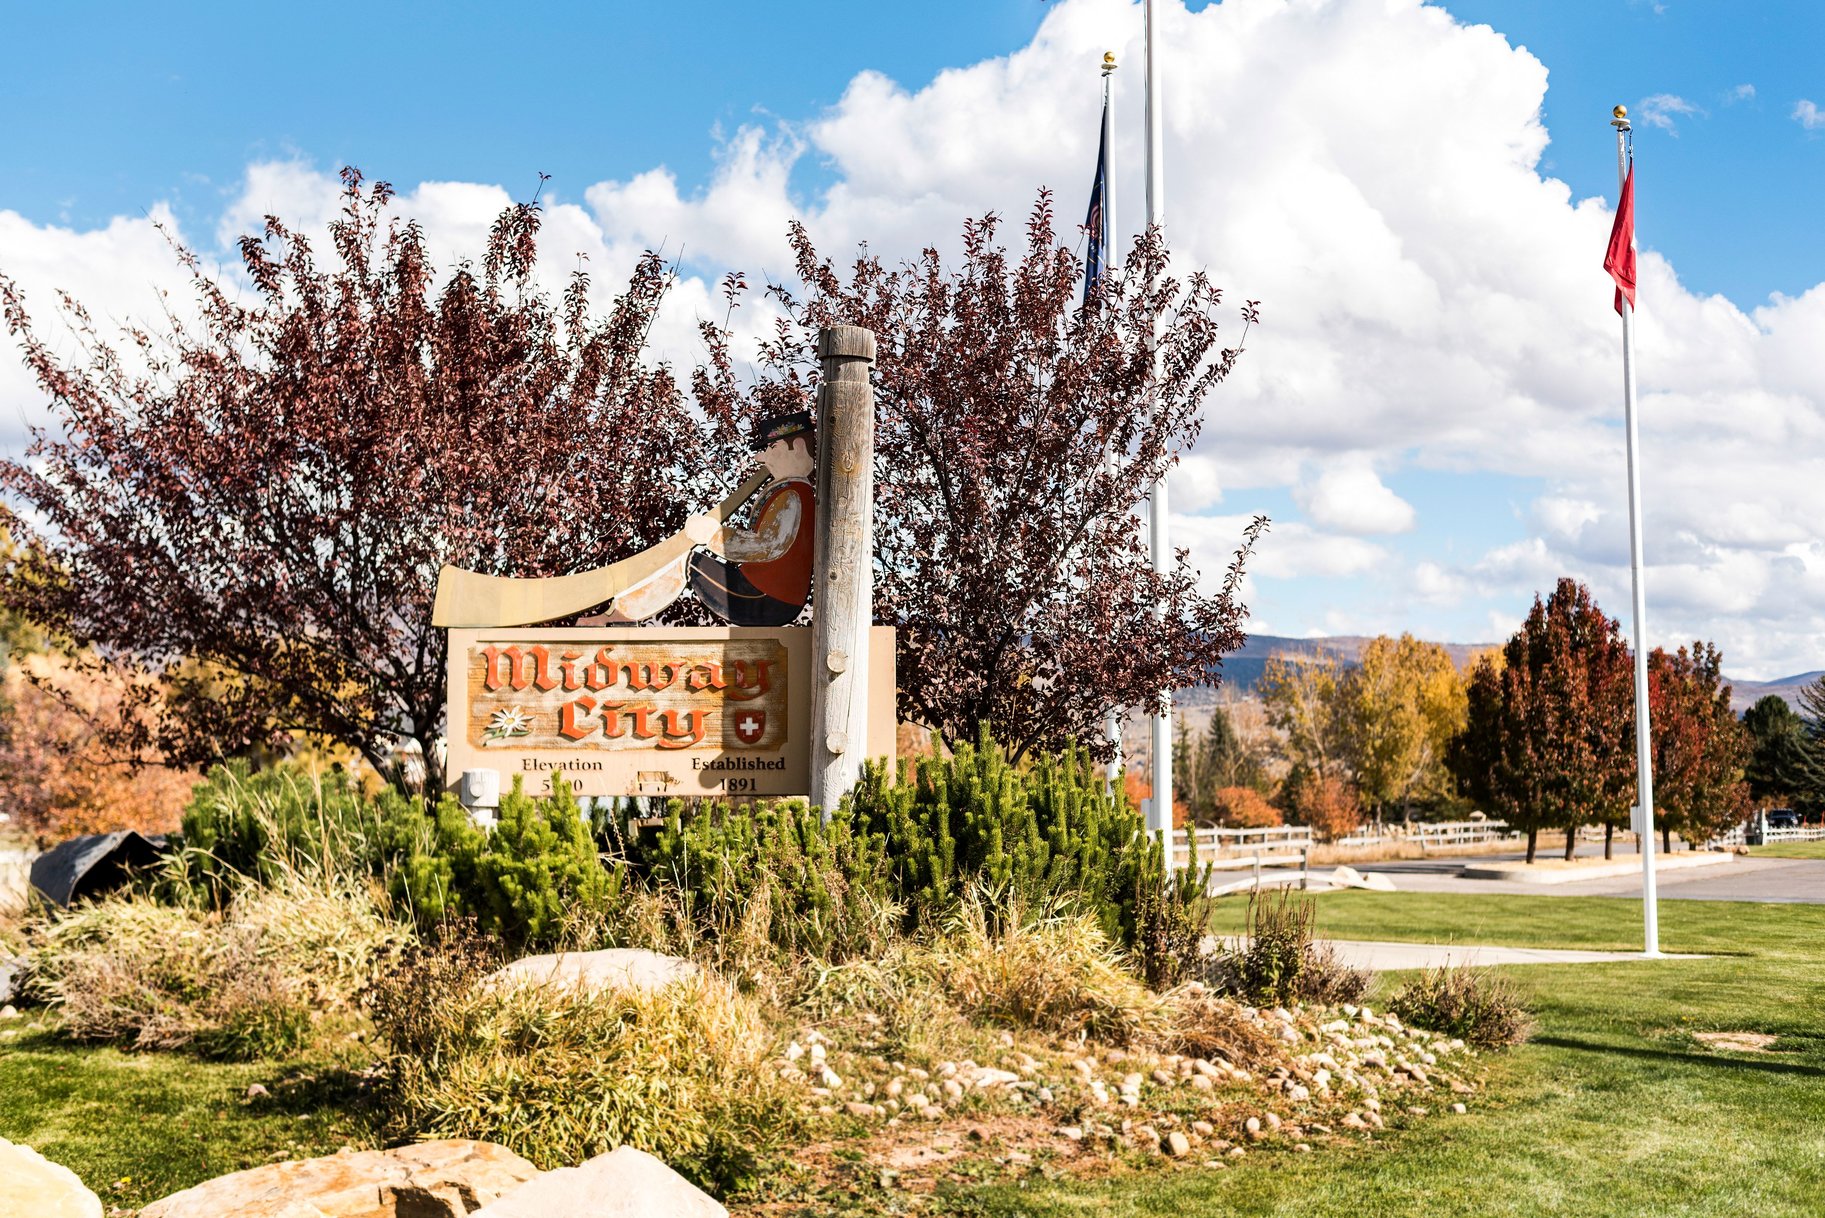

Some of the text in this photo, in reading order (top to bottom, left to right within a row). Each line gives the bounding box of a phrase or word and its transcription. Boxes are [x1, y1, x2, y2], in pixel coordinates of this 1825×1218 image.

[480, 644, 775, 701] Midway
[557, 695, 712, 749] City
[522, 758, 603, 771] Elevation
[692, 757, 786, 771] Established
[541, 779, 583, 792] 50
[720, 778, 757, 792] 1891
